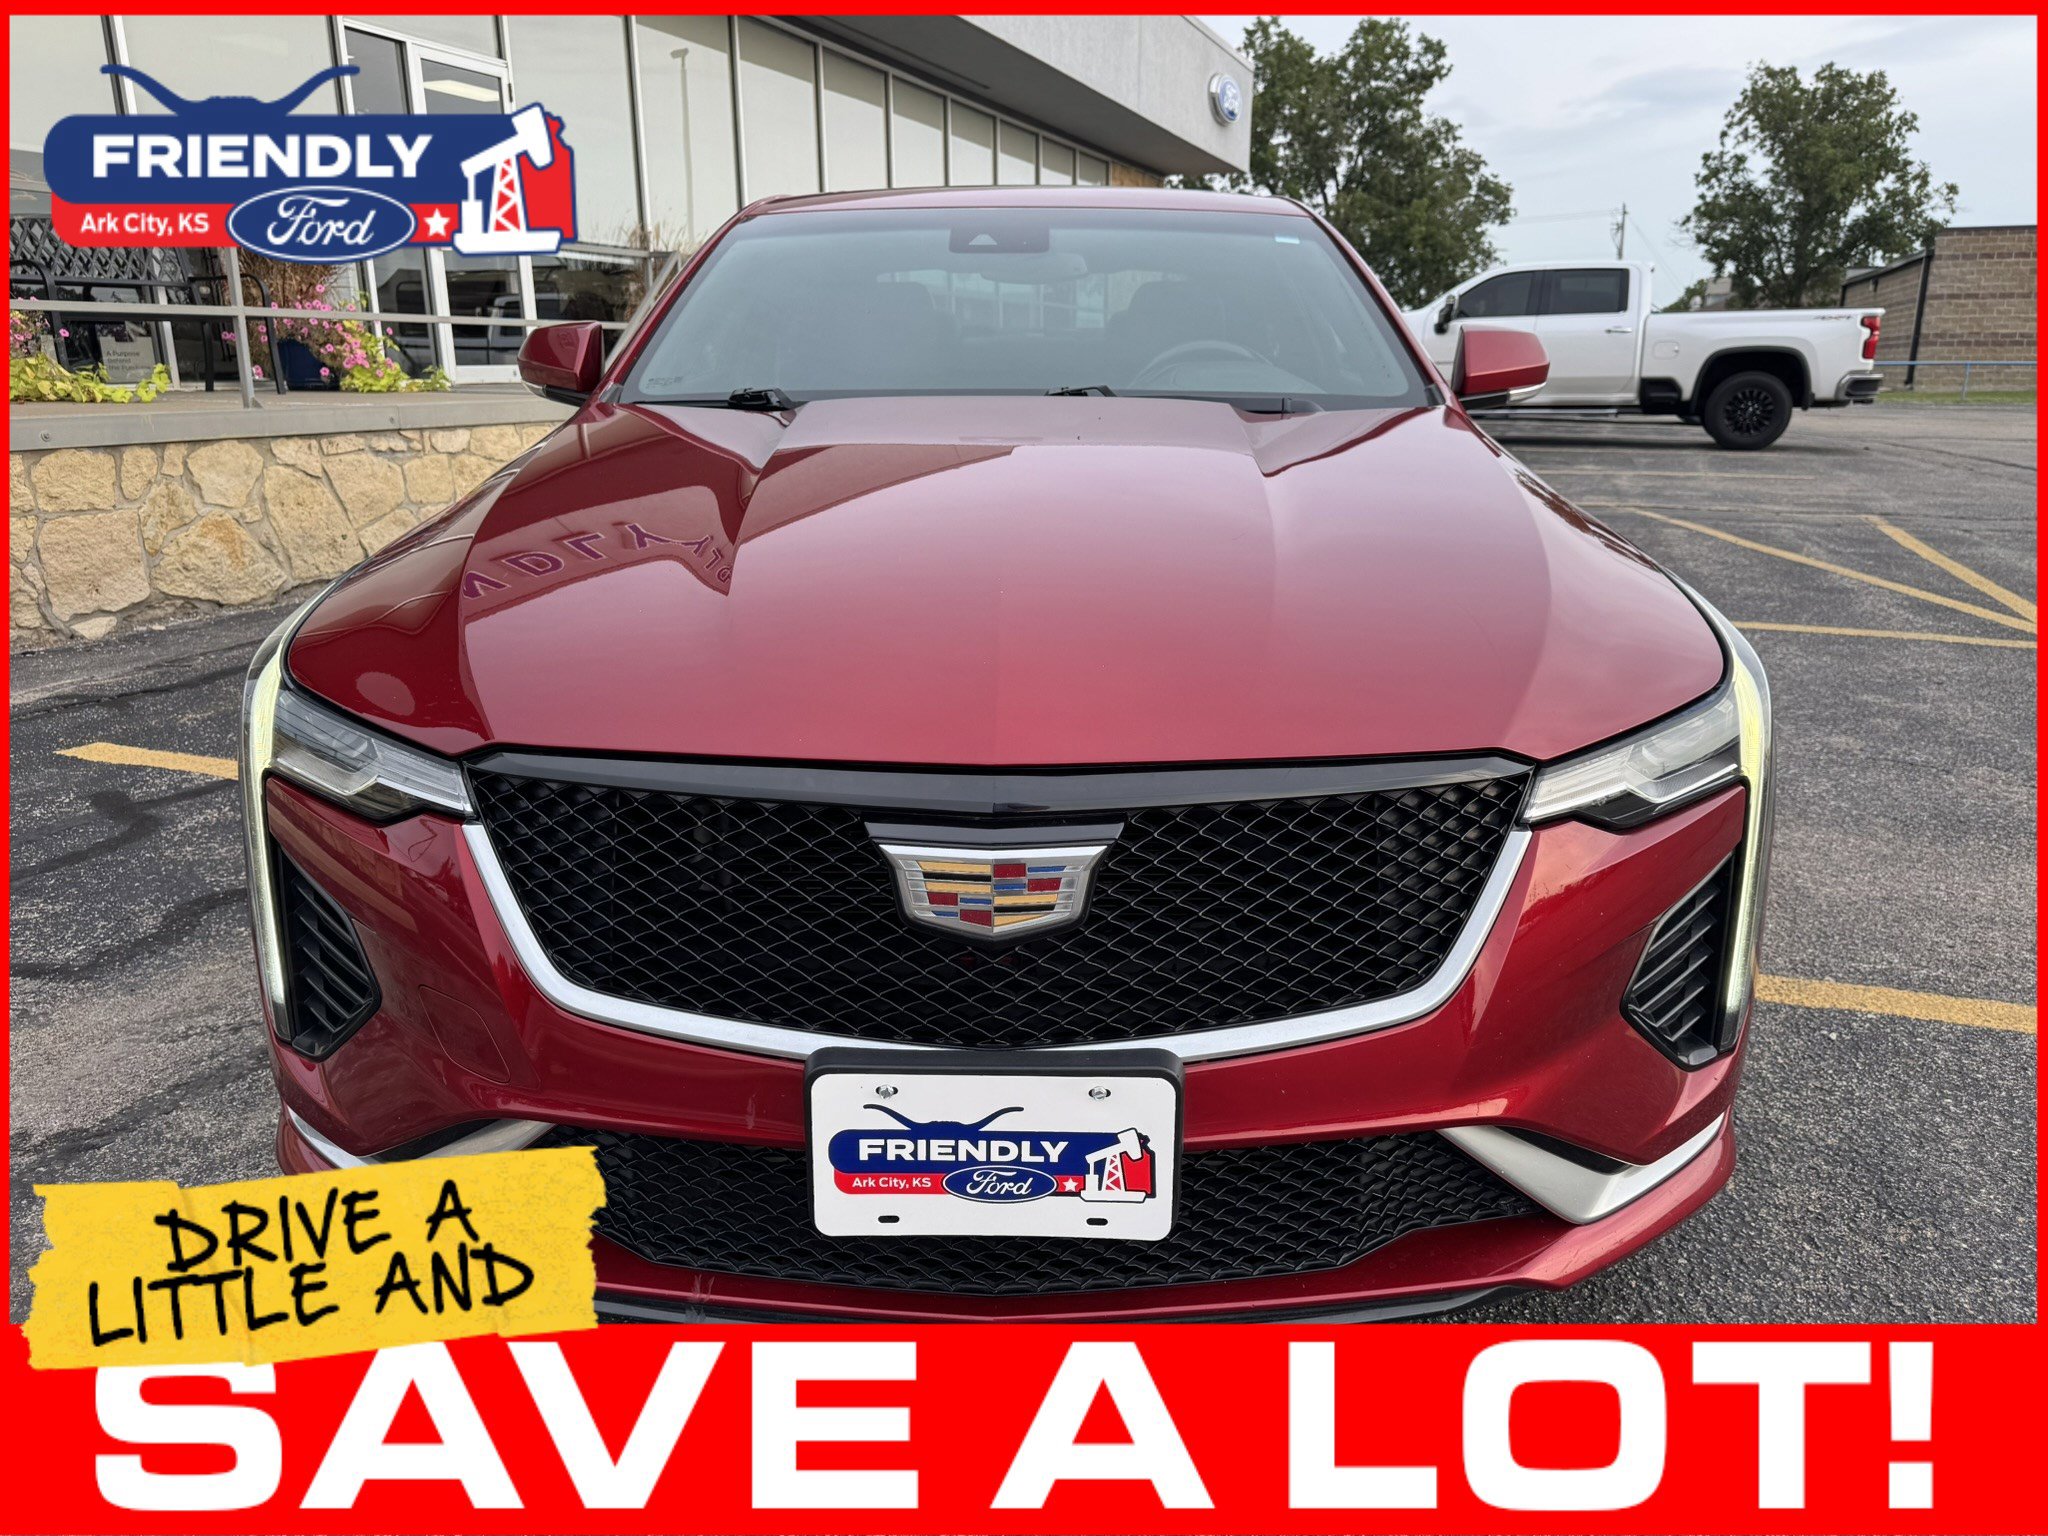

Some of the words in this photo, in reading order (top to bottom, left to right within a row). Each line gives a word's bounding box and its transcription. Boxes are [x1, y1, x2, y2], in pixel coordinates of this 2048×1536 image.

[858, 1138, 1069, 1163] FRIENDLY
[852, 1177, 876, 1188] Ark
[879, 1177, 910, 1190] City,
[912, 1177, 932, 1188] KS
[966, 1169, 1035, 1196] Ford
